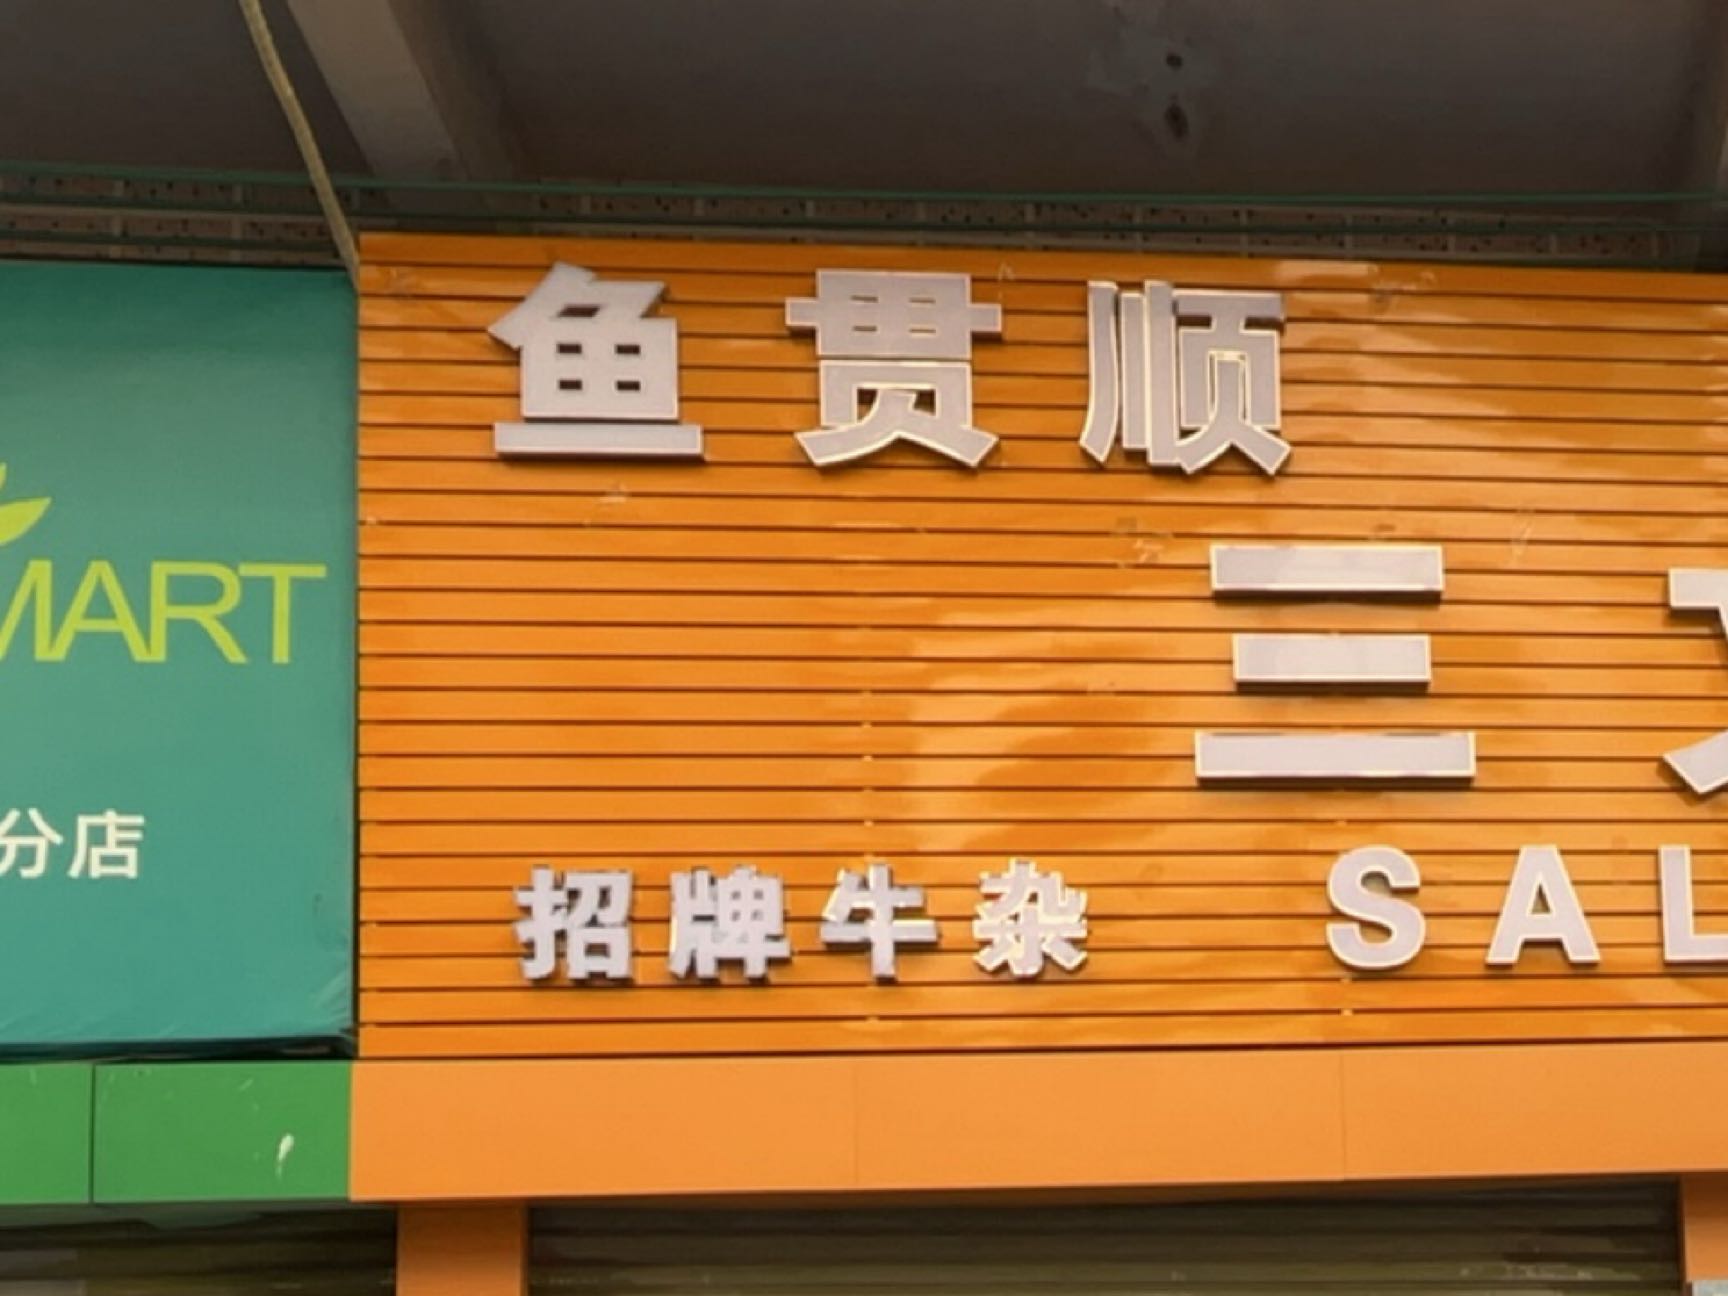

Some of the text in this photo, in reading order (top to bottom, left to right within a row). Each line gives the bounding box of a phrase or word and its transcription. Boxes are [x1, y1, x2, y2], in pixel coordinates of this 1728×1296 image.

[486, 259, 1292, 476] 鱼贯顺
[513, 858, 1088, 982] 招牌牛杂
